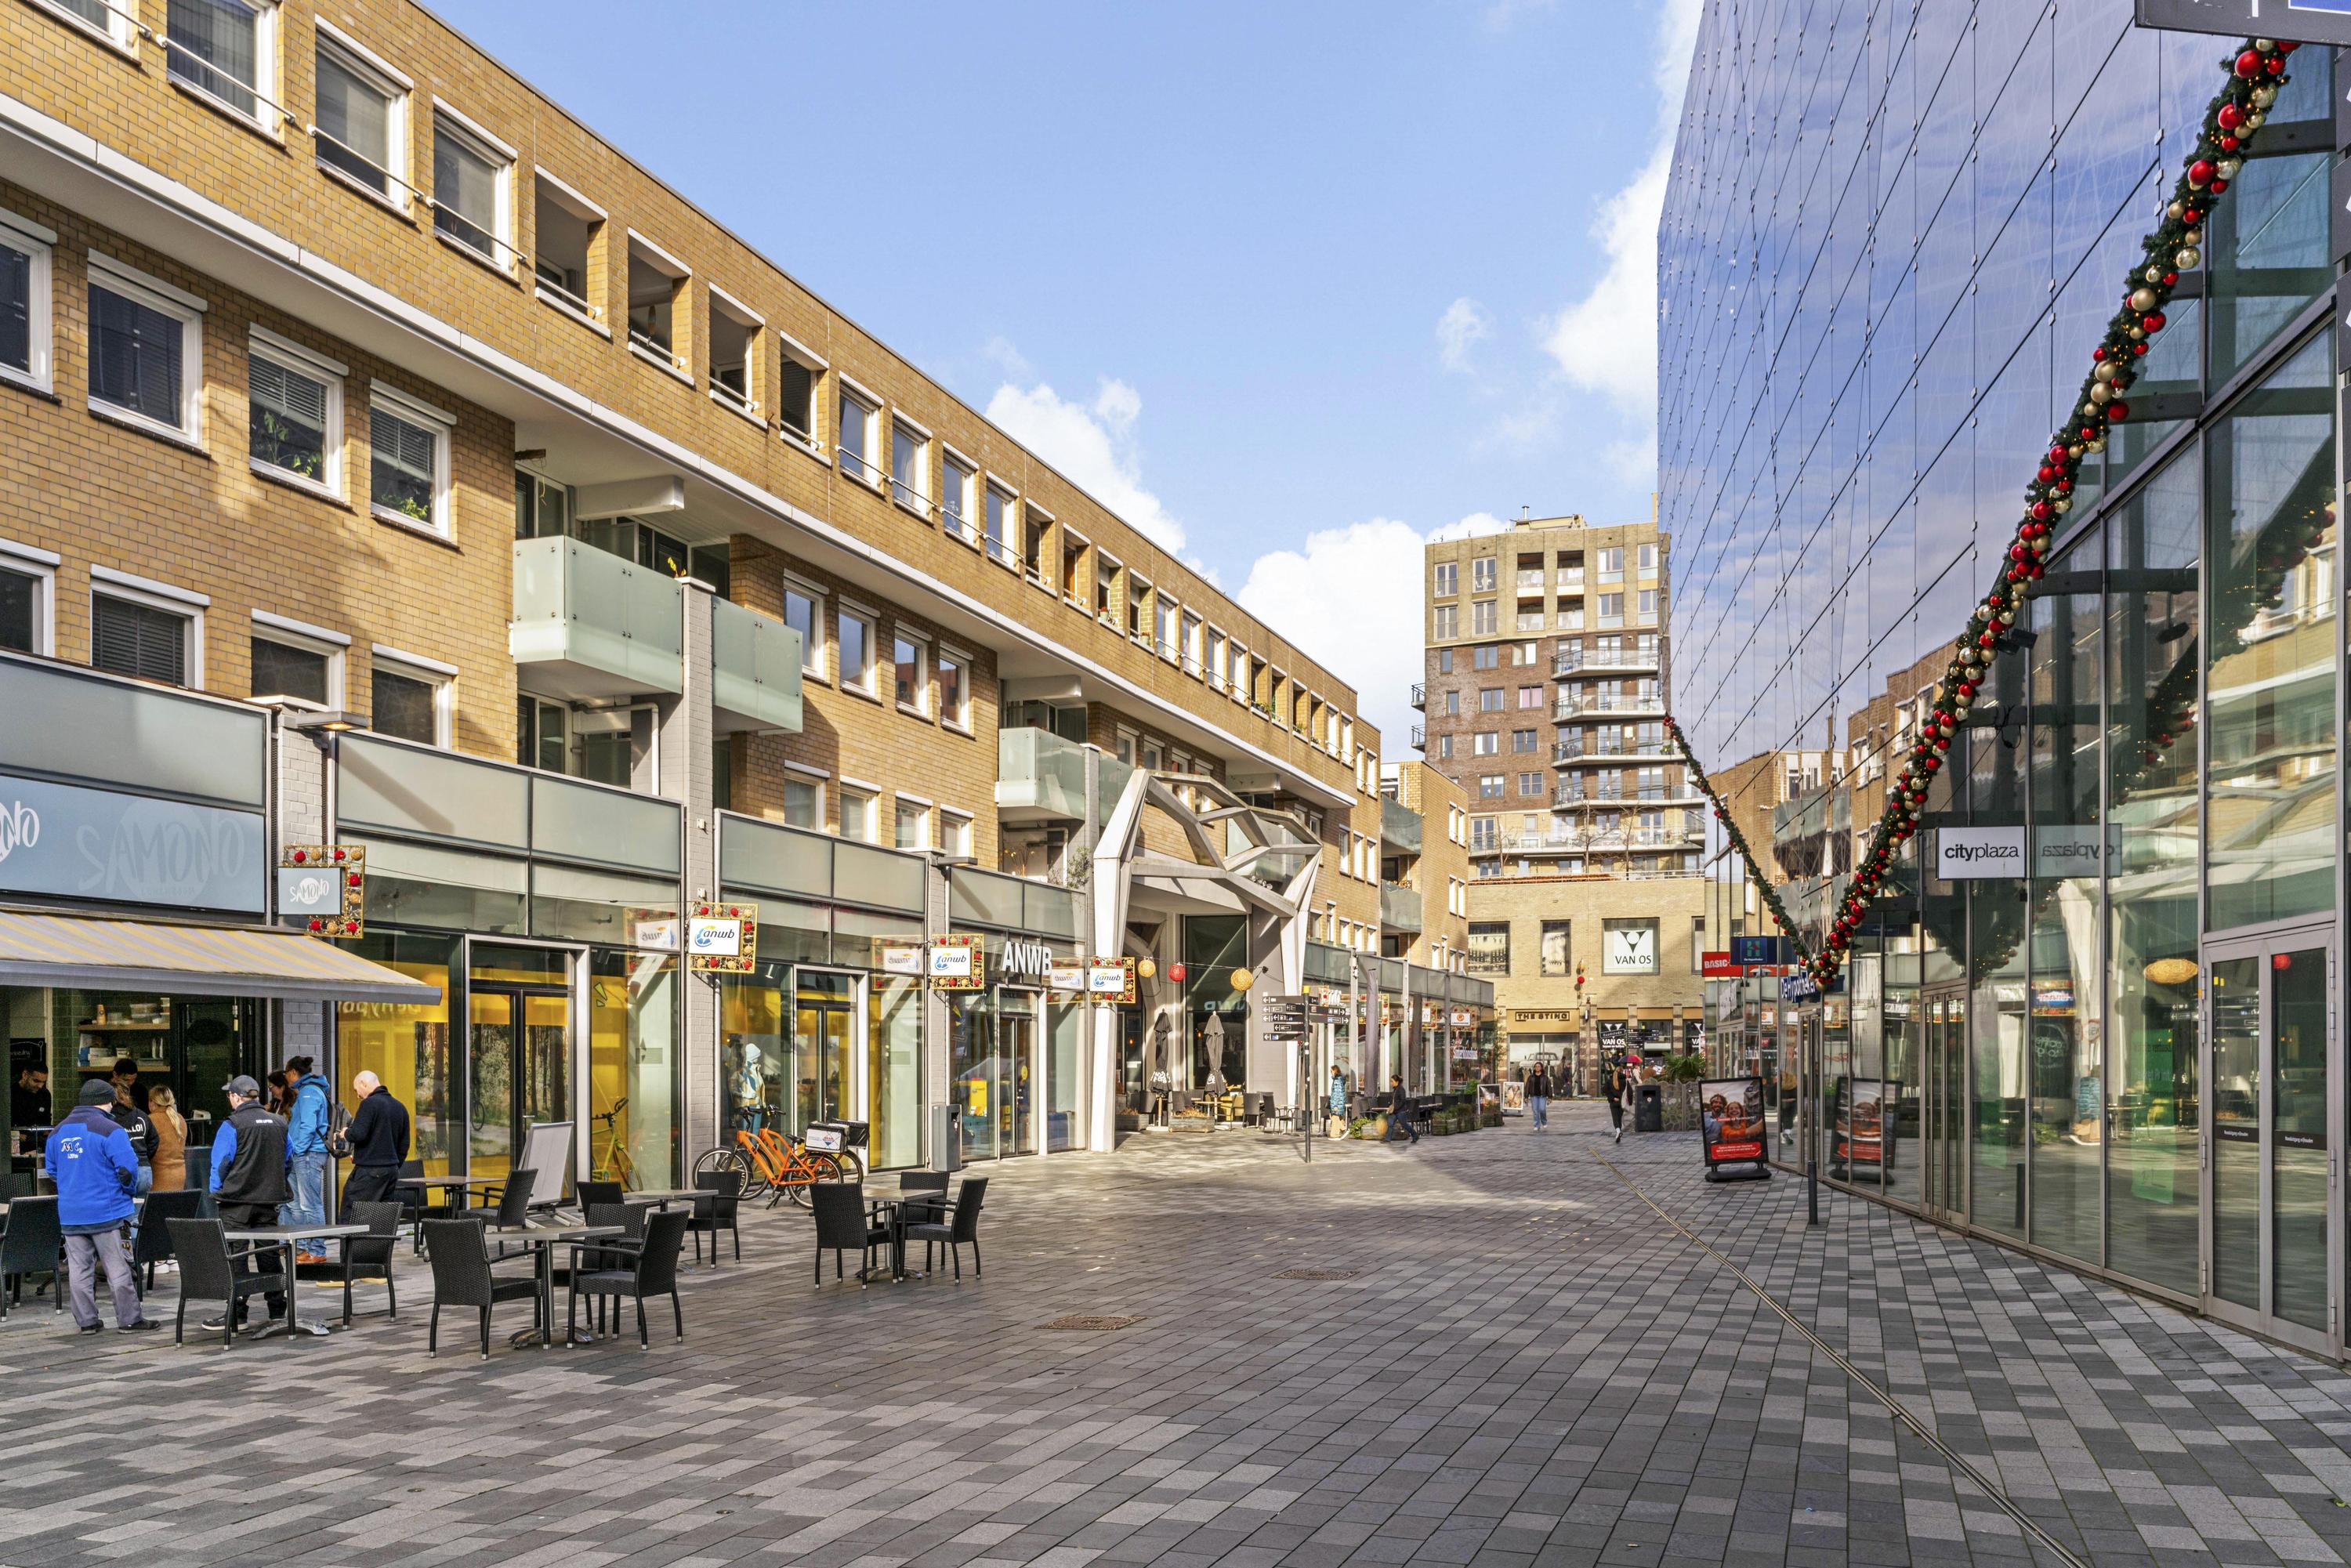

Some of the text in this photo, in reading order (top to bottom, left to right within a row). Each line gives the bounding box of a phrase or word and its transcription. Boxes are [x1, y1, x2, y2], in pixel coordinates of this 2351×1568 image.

[0, 800, 40, 848] NO
[76, 807, 245, 893] SAMONO
[1944, 843, 2019, 862] cityplaza
[290, 878, 329, 902] SAMONO
[703, 929, 735, 940] anwb
[1002, 940, 1052, 976] ANWB
[1615, 954, 1652, 965] VAN OS
